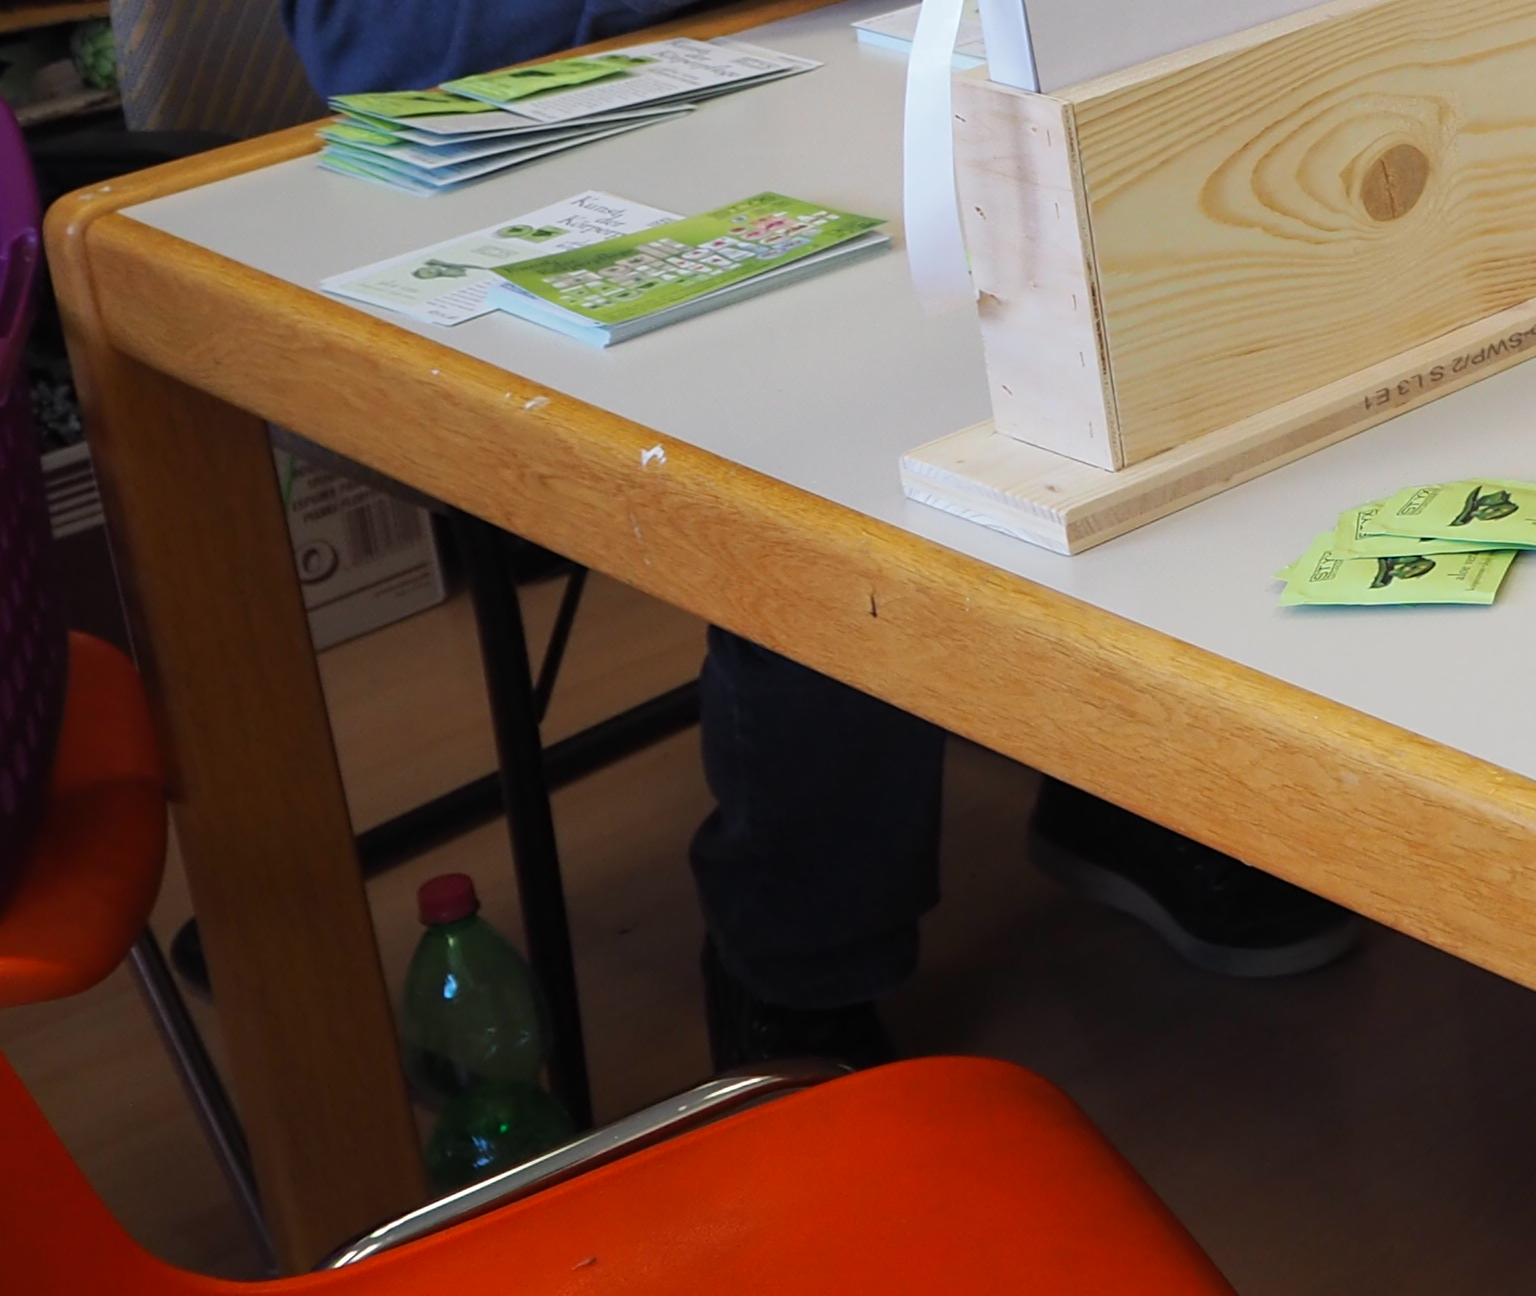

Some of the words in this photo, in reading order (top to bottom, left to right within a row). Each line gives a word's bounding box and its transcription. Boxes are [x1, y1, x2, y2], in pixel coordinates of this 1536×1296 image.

[1397, 372, 1425, 397] L3
[1430, 364, 1445, 383] S
[1364, 387, 1392, 412] E1
[1400, 487, 1432, 515] STYX
